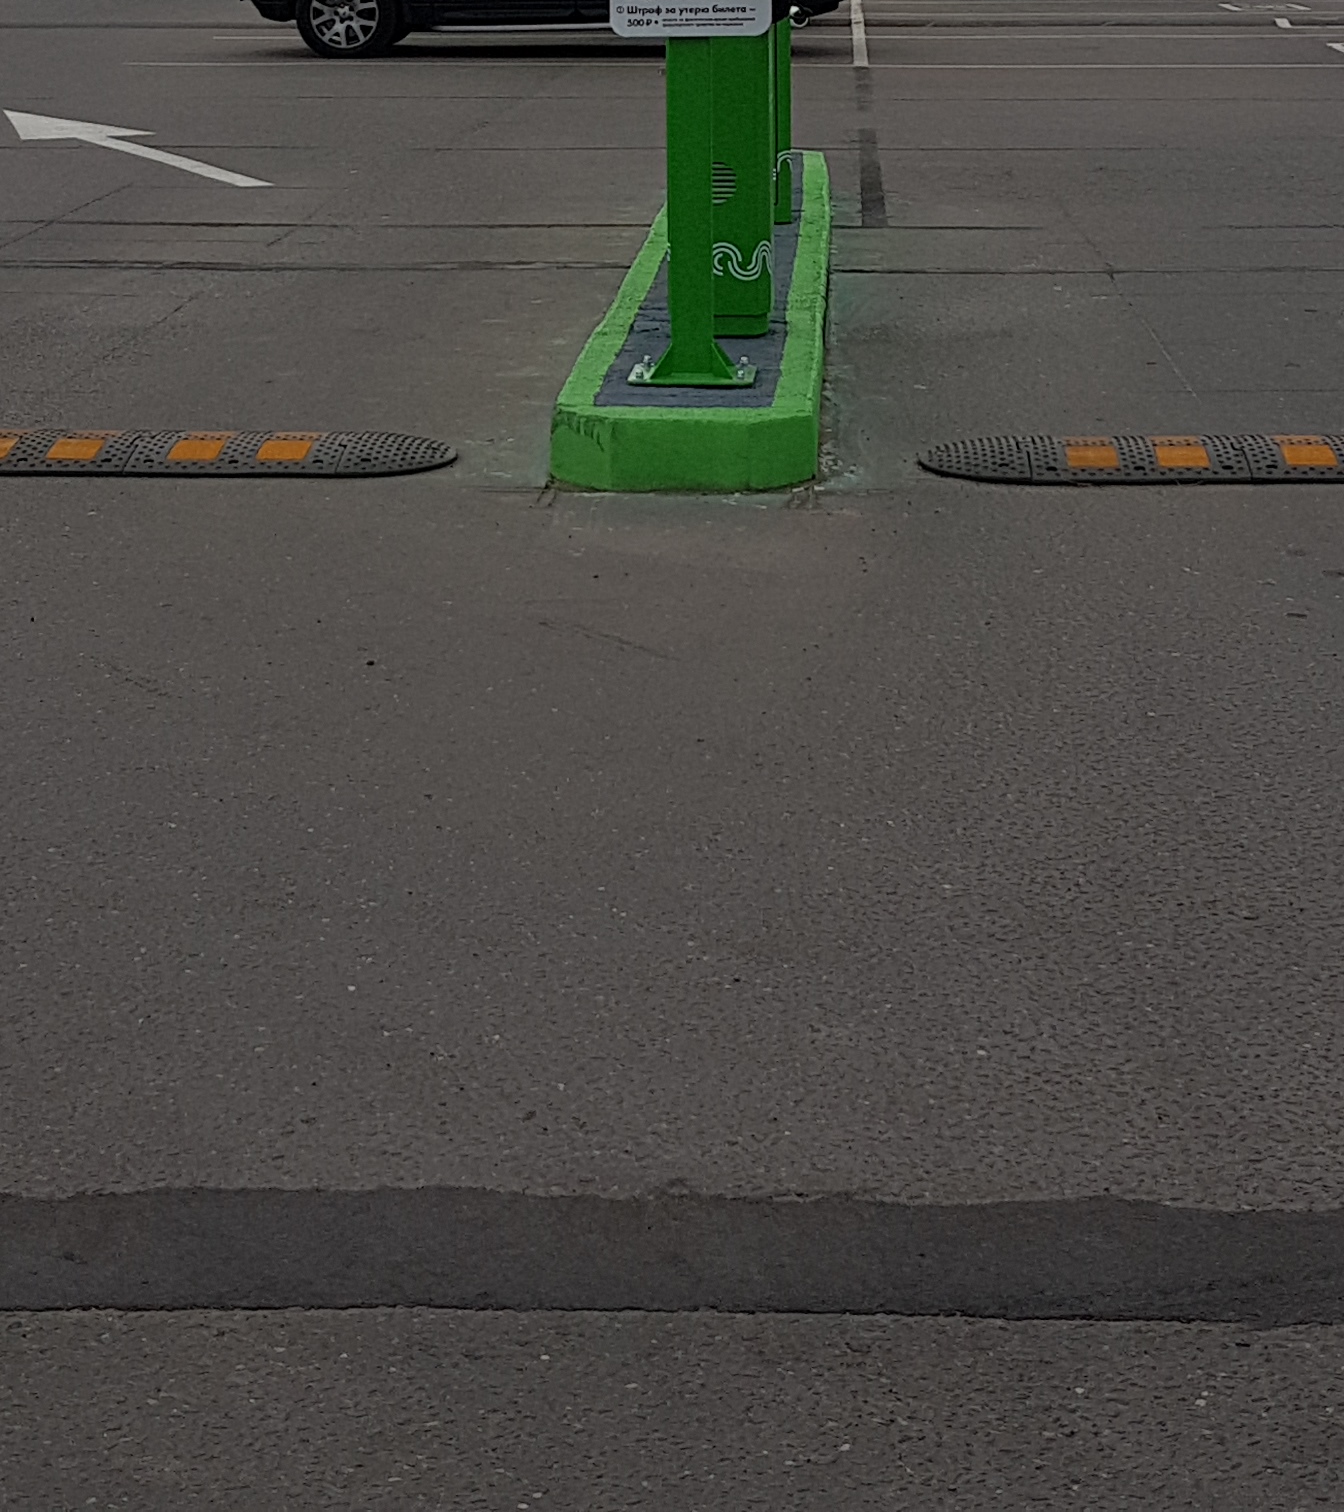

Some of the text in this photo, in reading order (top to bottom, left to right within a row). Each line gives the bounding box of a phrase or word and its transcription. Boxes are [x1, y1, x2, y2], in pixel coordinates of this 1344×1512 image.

[626, 5, 662, 17] Штраф
[678, 6, 710, 17] утерю
[712, 4, 747, 13] билета
